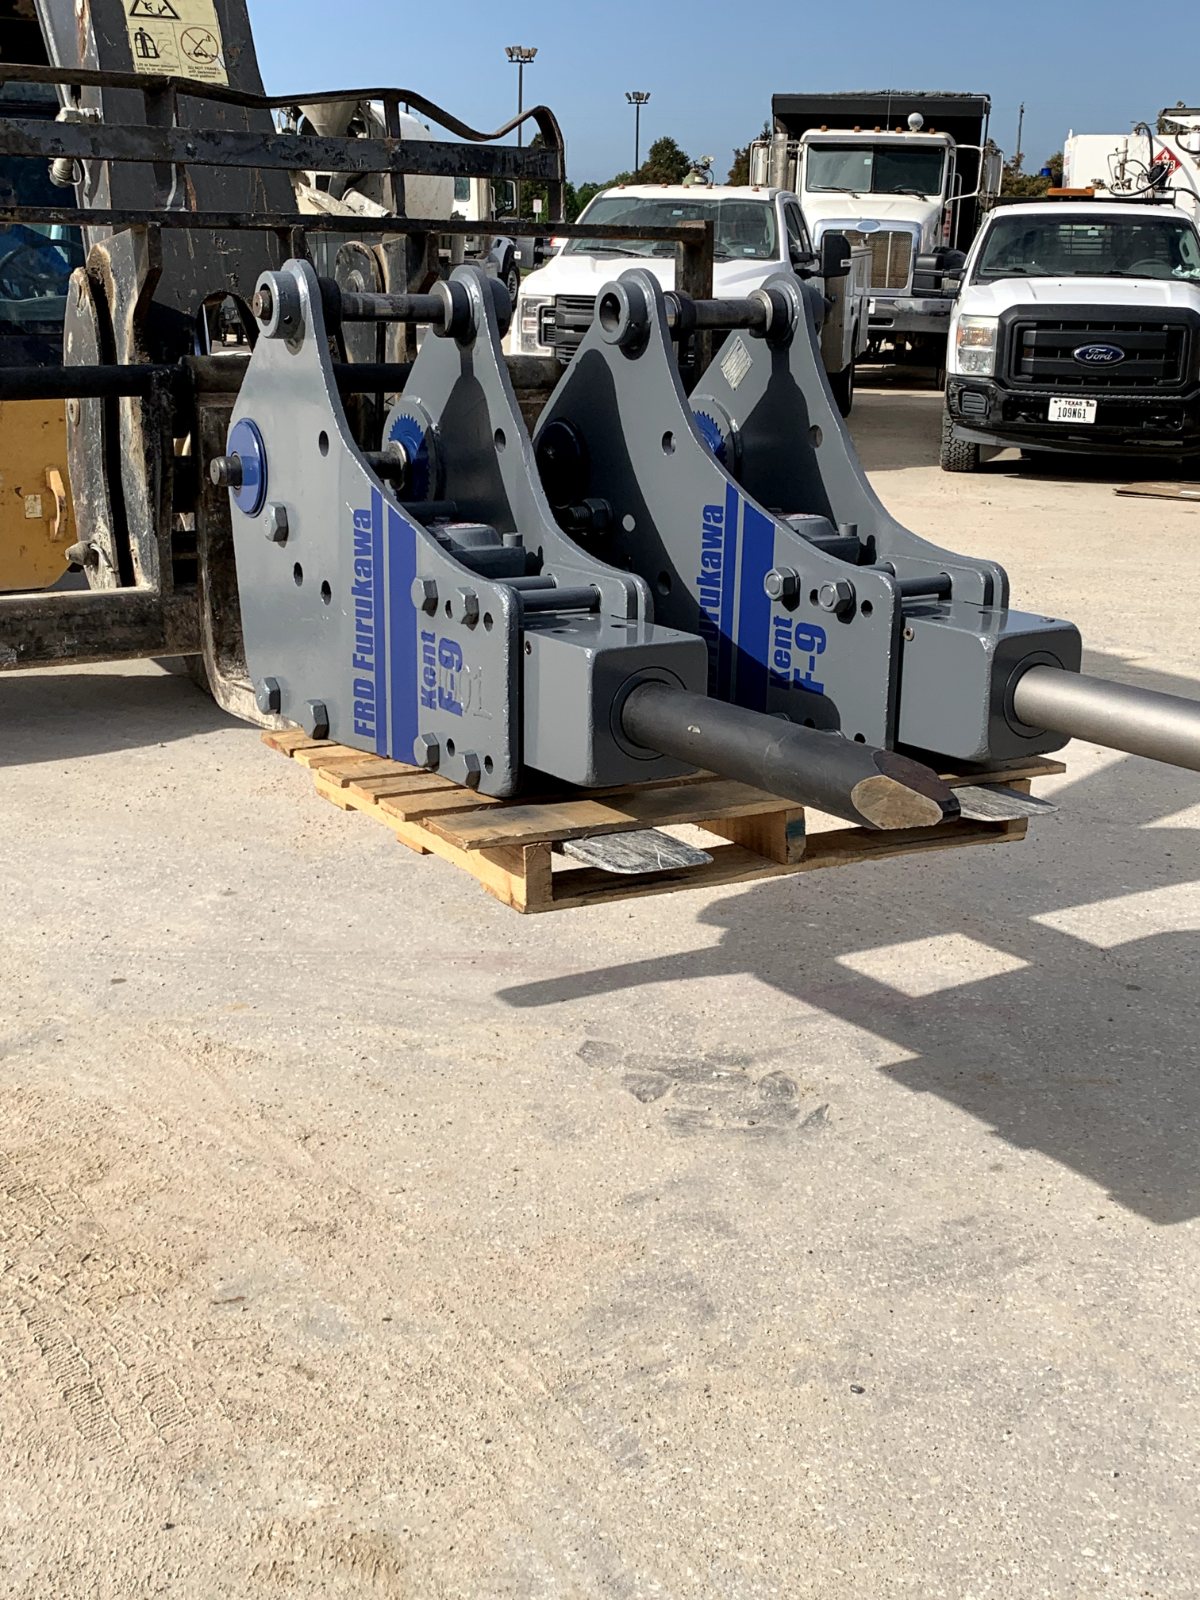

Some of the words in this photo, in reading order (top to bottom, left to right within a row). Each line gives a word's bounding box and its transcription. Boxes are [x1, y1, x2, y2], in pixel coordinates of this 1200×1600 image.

[1085, 347, 1113, 360] Ford
[1057, 407, 1086, 419] 109N61
[351, 508, 375, 671] Furukawa
[420, 629, 437, 710] Kent
[437, 637, 463, 717] F-9
[769, 615, 793, 691] Kent
[793, 622, 827, 696] F-9
[353, 677, 376, 738] FRD
